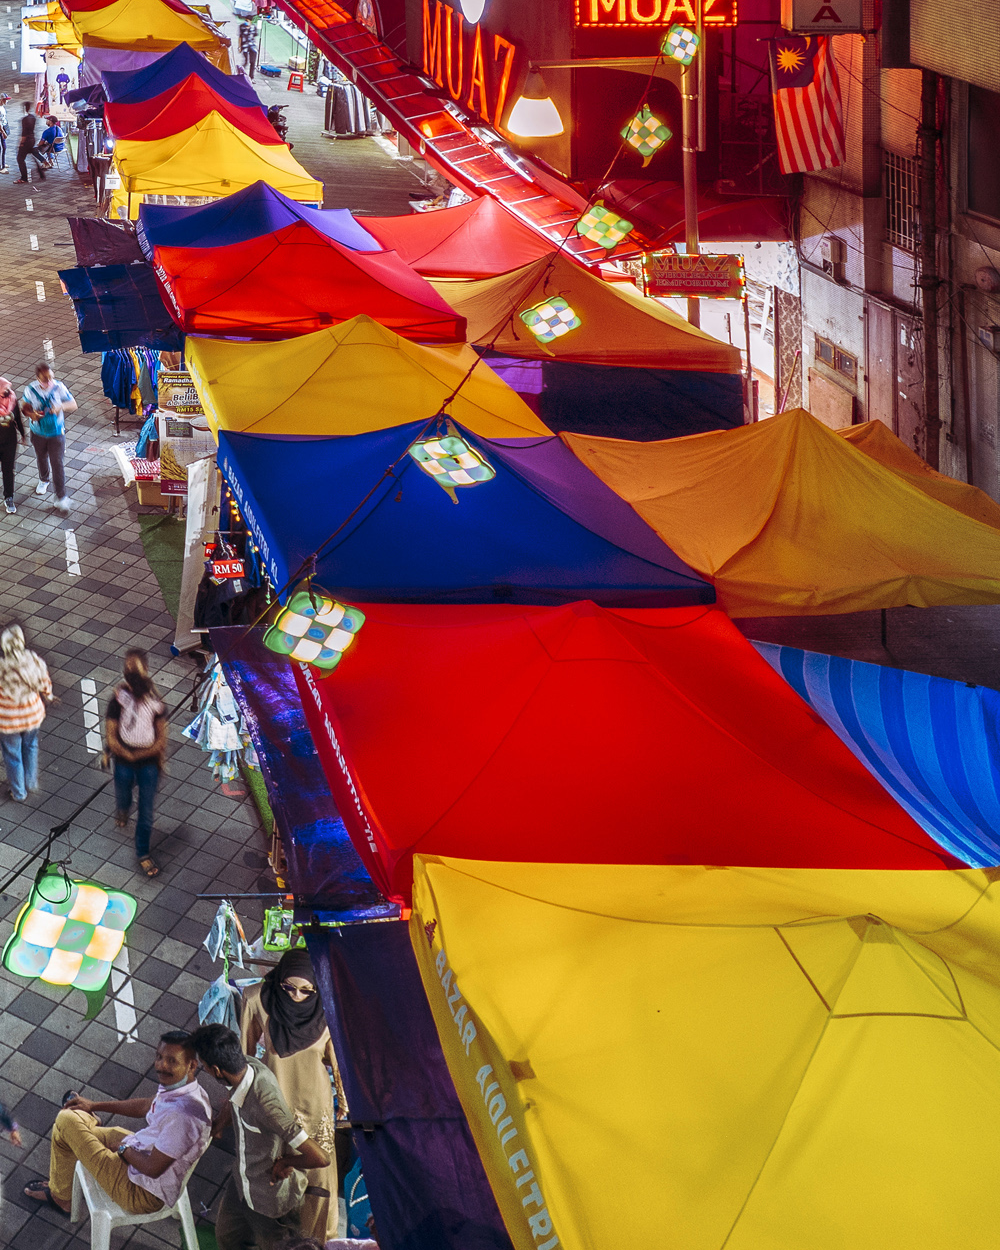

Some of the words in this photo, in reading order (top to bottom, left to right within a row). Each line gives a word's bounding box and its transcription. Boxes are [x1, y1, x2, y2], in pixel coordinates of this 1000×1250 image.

[652, 256, 731, 272] MUAZ
[655, 279, 730, 288] EMPORIUM
[228, 465, 244, 504] BAZAR
[244, 500, 270, 561] AIDILFITRI
[270, 558, 278, 585] KL
[214, 564, 231, 575] RM
[231, 563, 243, 573] 50
[435, 948, 477, 1057] BAZAR
